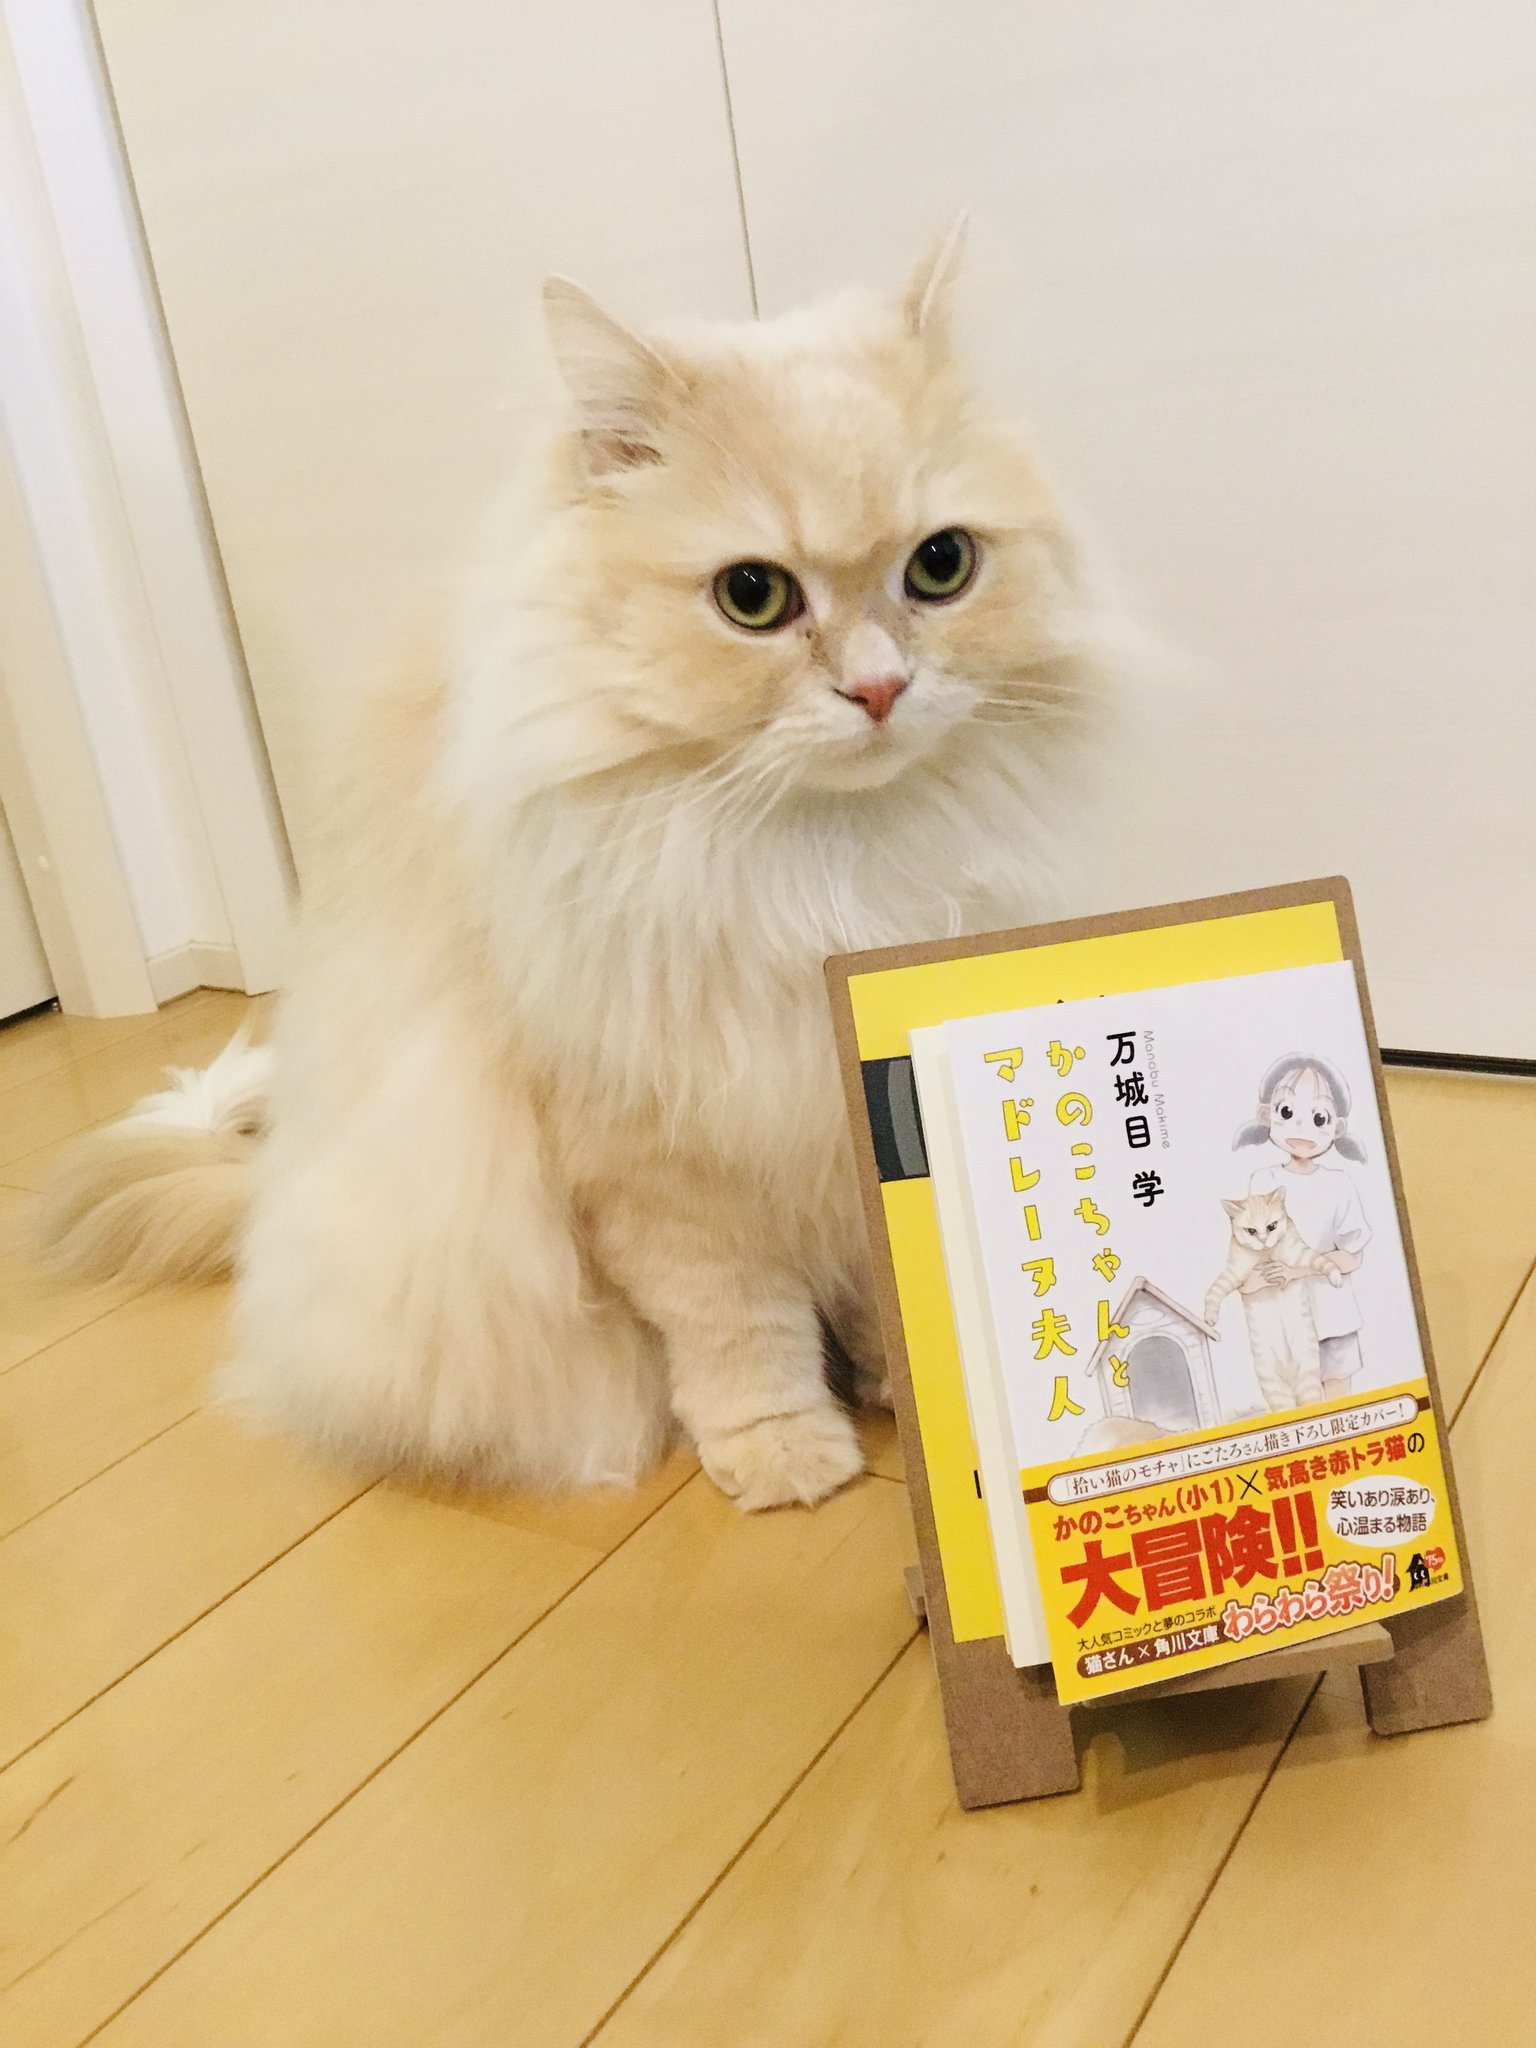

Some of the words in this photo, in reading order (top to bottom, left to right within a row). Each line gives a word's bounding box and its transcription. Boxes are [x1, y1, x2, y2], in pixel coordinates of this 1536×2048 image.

[1143, 1030, 1159, 1088] Manabu
[1154, 1093, 1170, 1149] Makime
[984, 1047, 1085, 1421] マドレーヌ夫人
[1046, 1040, 1130, 1387] かのこちゃんと
[1060, 1491, 1324, 1629] 大冒険!!
[1336, 1512, 1427, 1536] 心温まる物語
[1077, 1605, 1217, 1652] 大人気コミックと夢のコラボ
[1221, 1553, 1396, 1641] わらわら祭り!
